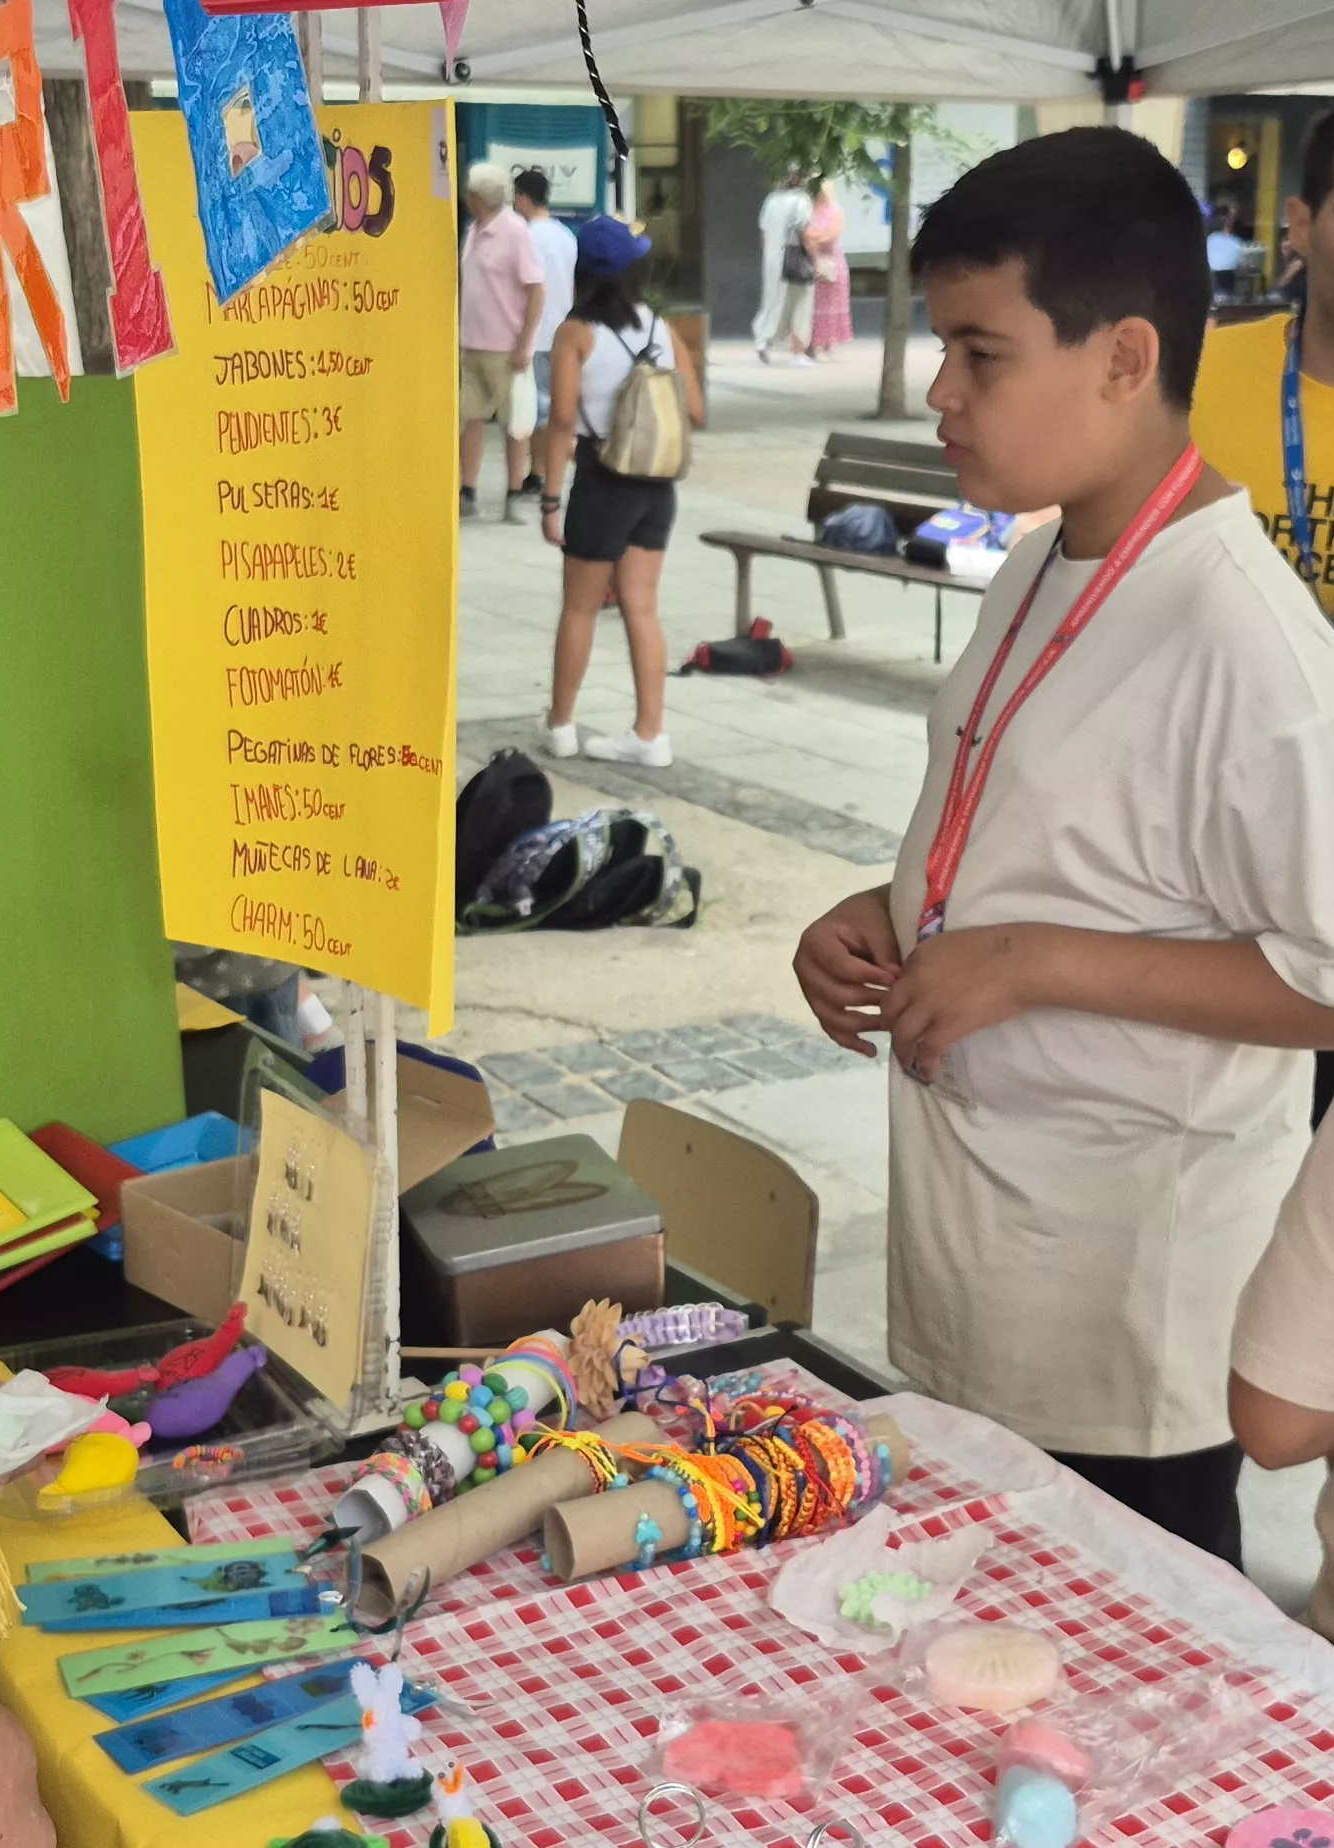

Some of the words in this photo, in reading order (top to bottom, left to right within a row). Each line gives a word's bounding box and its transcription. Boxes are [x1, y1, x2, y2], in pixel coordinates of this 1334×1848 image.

[322, 743, 340, 767] DE
[232, 838, 311, 877] MUÑECAS
[317, 851, 331, 876] DE
